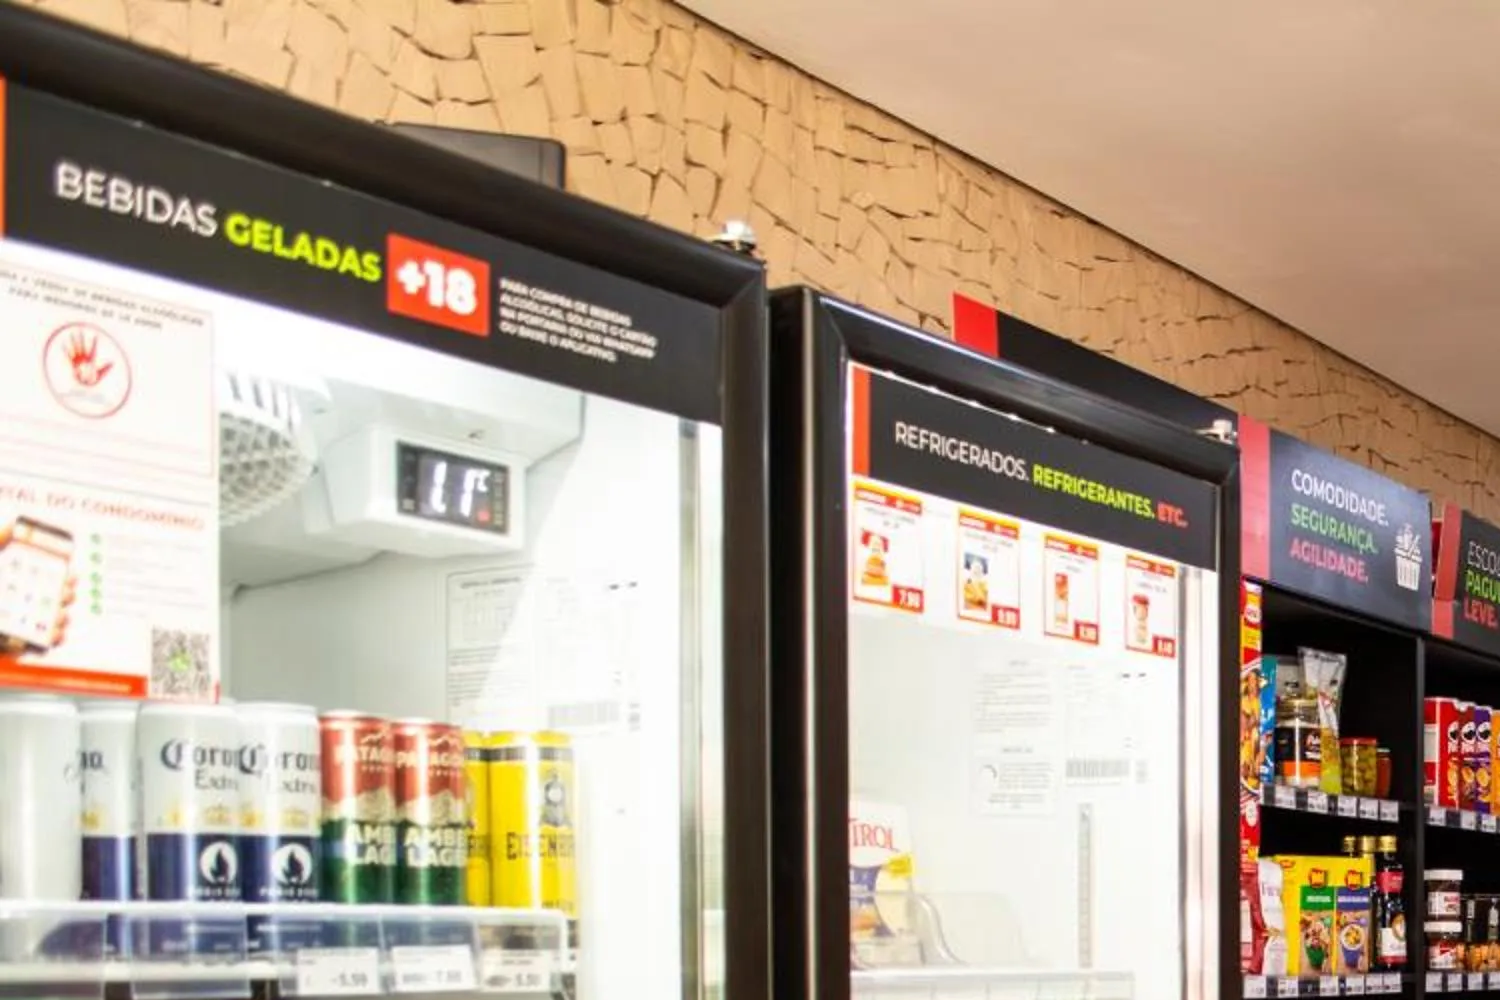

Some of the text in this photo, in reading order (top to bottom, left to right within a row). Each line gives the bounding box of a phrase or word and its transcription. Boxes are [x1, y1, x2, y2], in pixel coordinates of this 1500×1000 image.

[55, 161, 477, 315] BEBIDAS GELADAS +18
[895, 421, 1189, 528] REFRIGERADOS. REFRIGERANTES. ETC.
[1291, 468, 1389, 527] COMODIDADE.
[1291, 502, 1379, 555] SEGURANÇA.
[1290, 538, 1368, 584] AGILIDADE.
